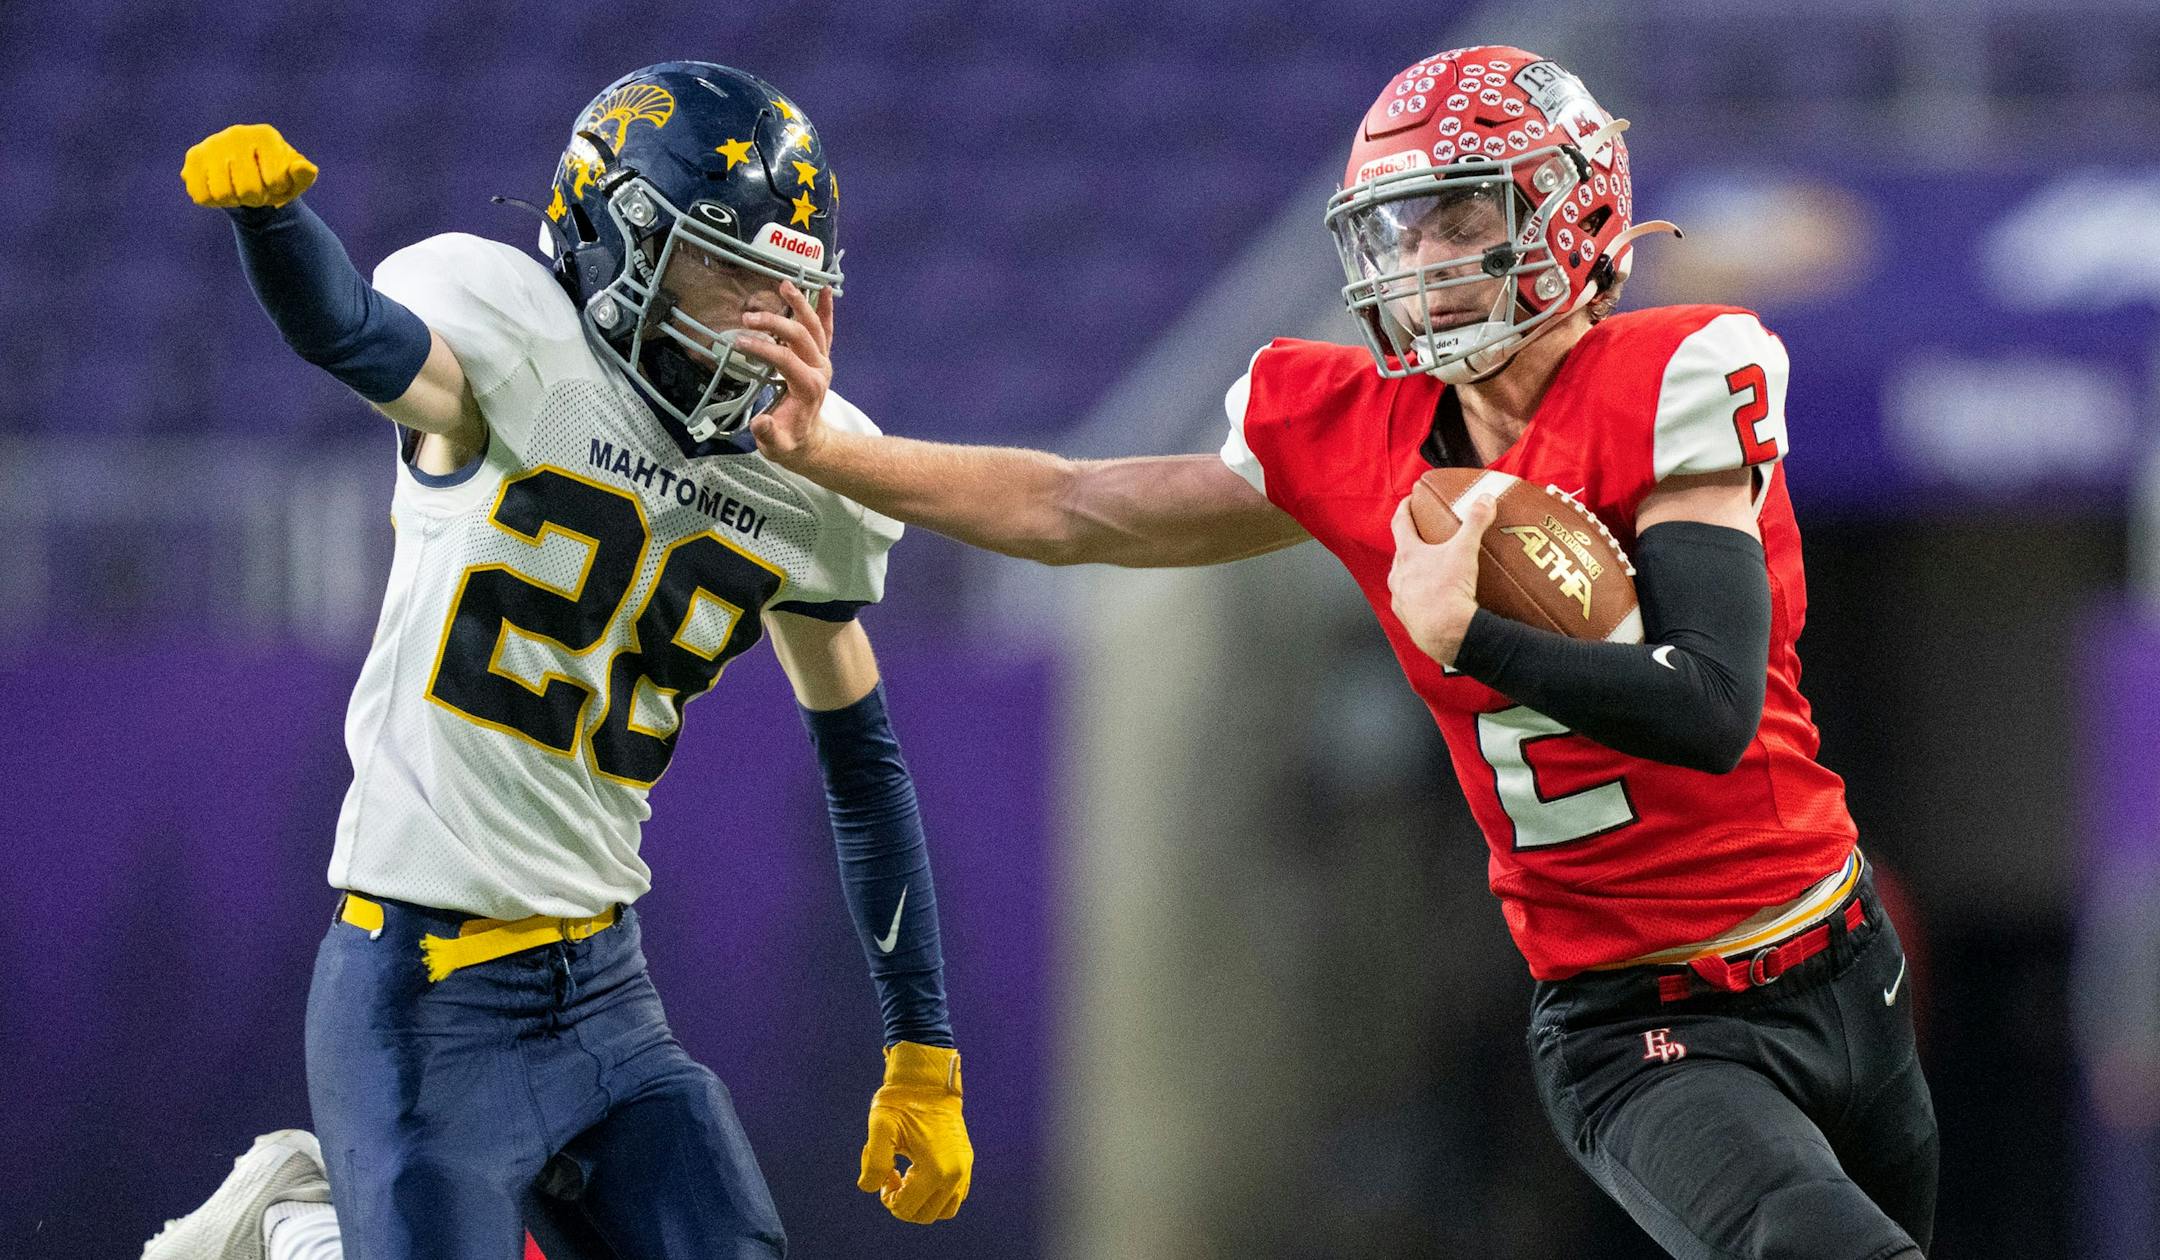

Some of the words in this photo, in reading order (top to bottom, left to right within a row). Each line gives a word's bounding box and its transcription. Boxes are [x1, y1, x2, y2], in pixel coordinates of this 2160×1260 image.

[769, 230, 821, 260] Riddell
[1724, 363, 1779, 467] 2
[589, 438, 767, 540] MAHTOMEDI
[424, 464, 787, 790] 28
